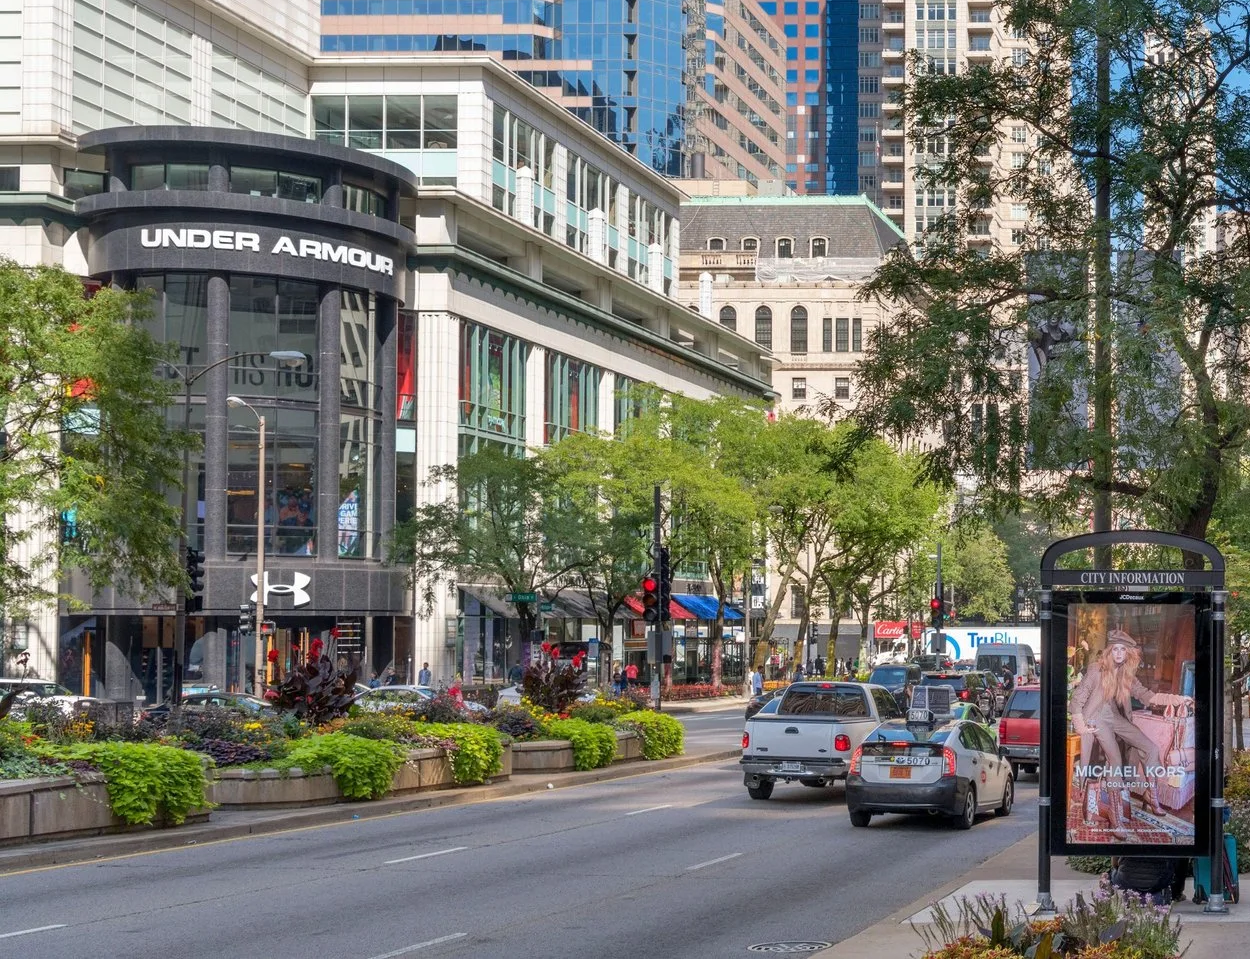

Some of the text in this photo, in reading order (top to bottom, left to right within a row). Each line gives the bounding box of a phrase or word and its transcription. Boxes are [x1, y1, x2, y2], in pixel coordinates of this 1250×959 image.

[141, 229, 394, 276] UNDER ARMOUR
[1081, 572, 1185, 584] CITY INFORMATION
[877, 624, 903, 635] Cartie
[911, 710, 928, 720] 5070
[907, 757, 930, 765] 5070
[1075, 766, 1186, 778] MICHAEL KORS
